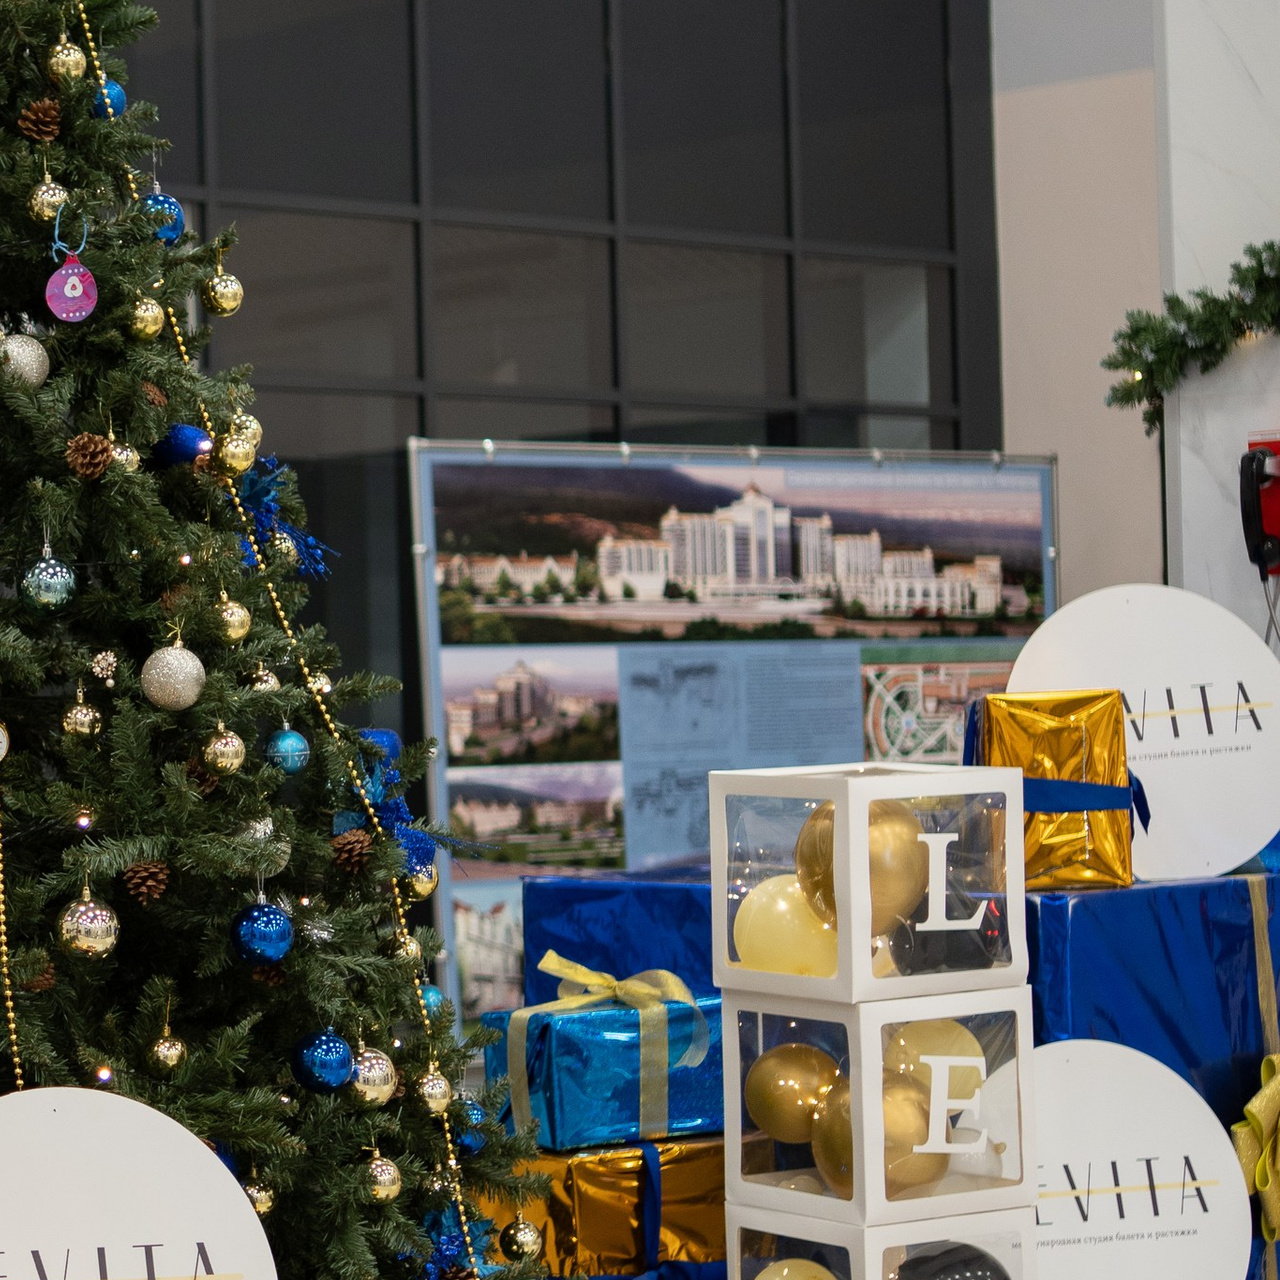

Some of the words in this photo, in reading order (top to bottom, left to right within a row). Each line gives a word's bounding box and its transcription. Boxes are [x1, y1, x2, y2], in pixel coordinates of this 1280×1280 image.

[1121, 680, 1262, 741] VITA
[916, 833, 988, 931] L
[913, 1055, 988, 1154] E
[1115, 1231, 1145, 1242] балета
[1155, 1228, 1198, 1240] растяжки
